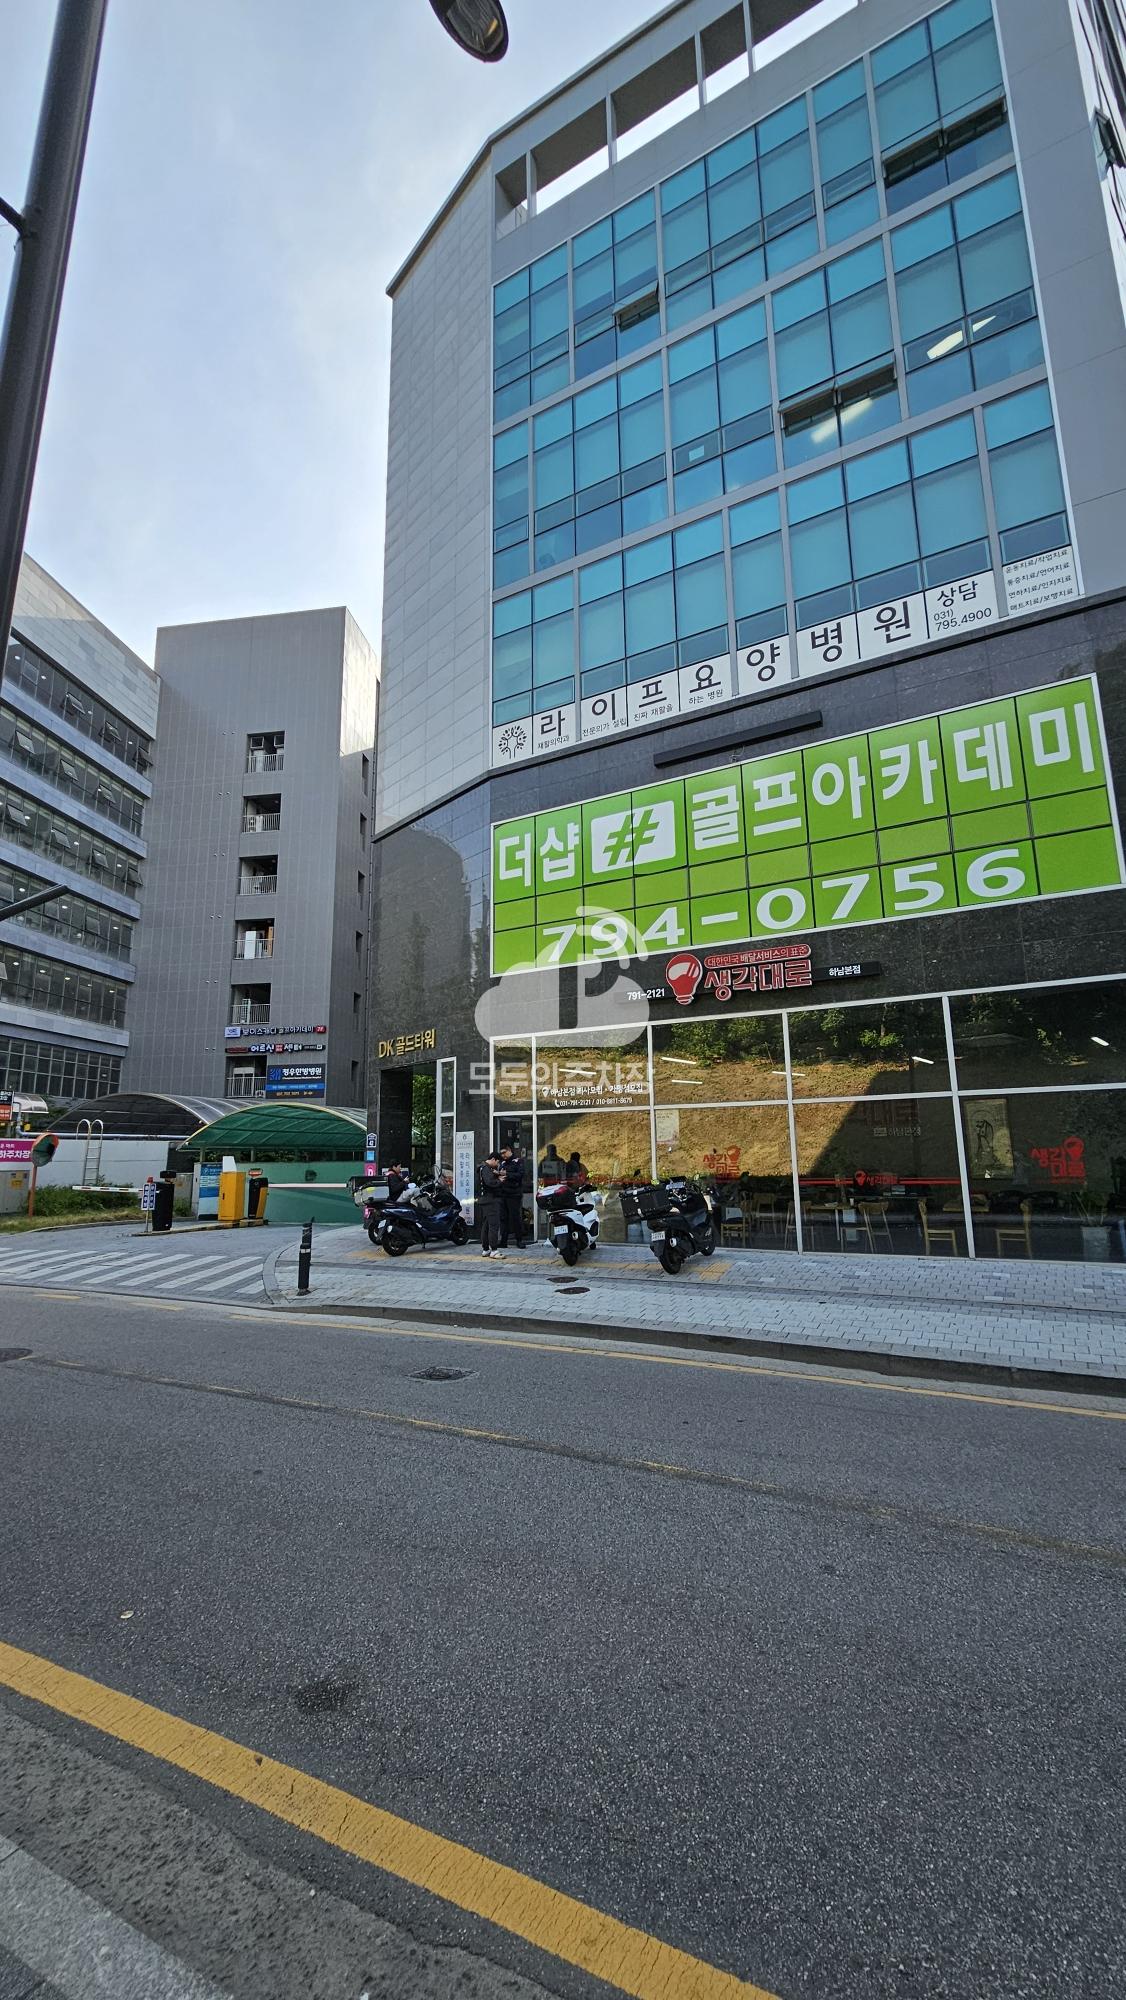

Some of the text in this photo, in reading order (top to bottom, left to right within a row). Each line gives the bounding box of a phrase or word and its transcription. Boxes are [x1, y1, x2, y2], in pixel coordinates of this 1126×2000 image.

[937, 580, 979, 608] 상담
[933, 608, 954, 622] 031)
[935, 607, 993, 632] 795.4900
[582, 723, 610, 738] 전문의가
[634, 711, 648, 723] 진짜
[650, 703, 673, 717] 재활을
[688, 694, 704, 706] 하는
[707, 688, 724, 701] 병원
[499, 822, 580, 887] 더샵
[691, 702, 1096, 851] 골프아카데미
[542, 849, 1026, 963] 794-0756
[706, 954, 739, 968] 대한민국
[740, 947, 790, 964] 배달서비스의
[828, 964, 861, 977] 하남본점
[627, 987, 665, 1001] 791-2121
[704, 959, 812, 1001] 생각대로
[378, 1028, 436, 1058] DK 골드타워
